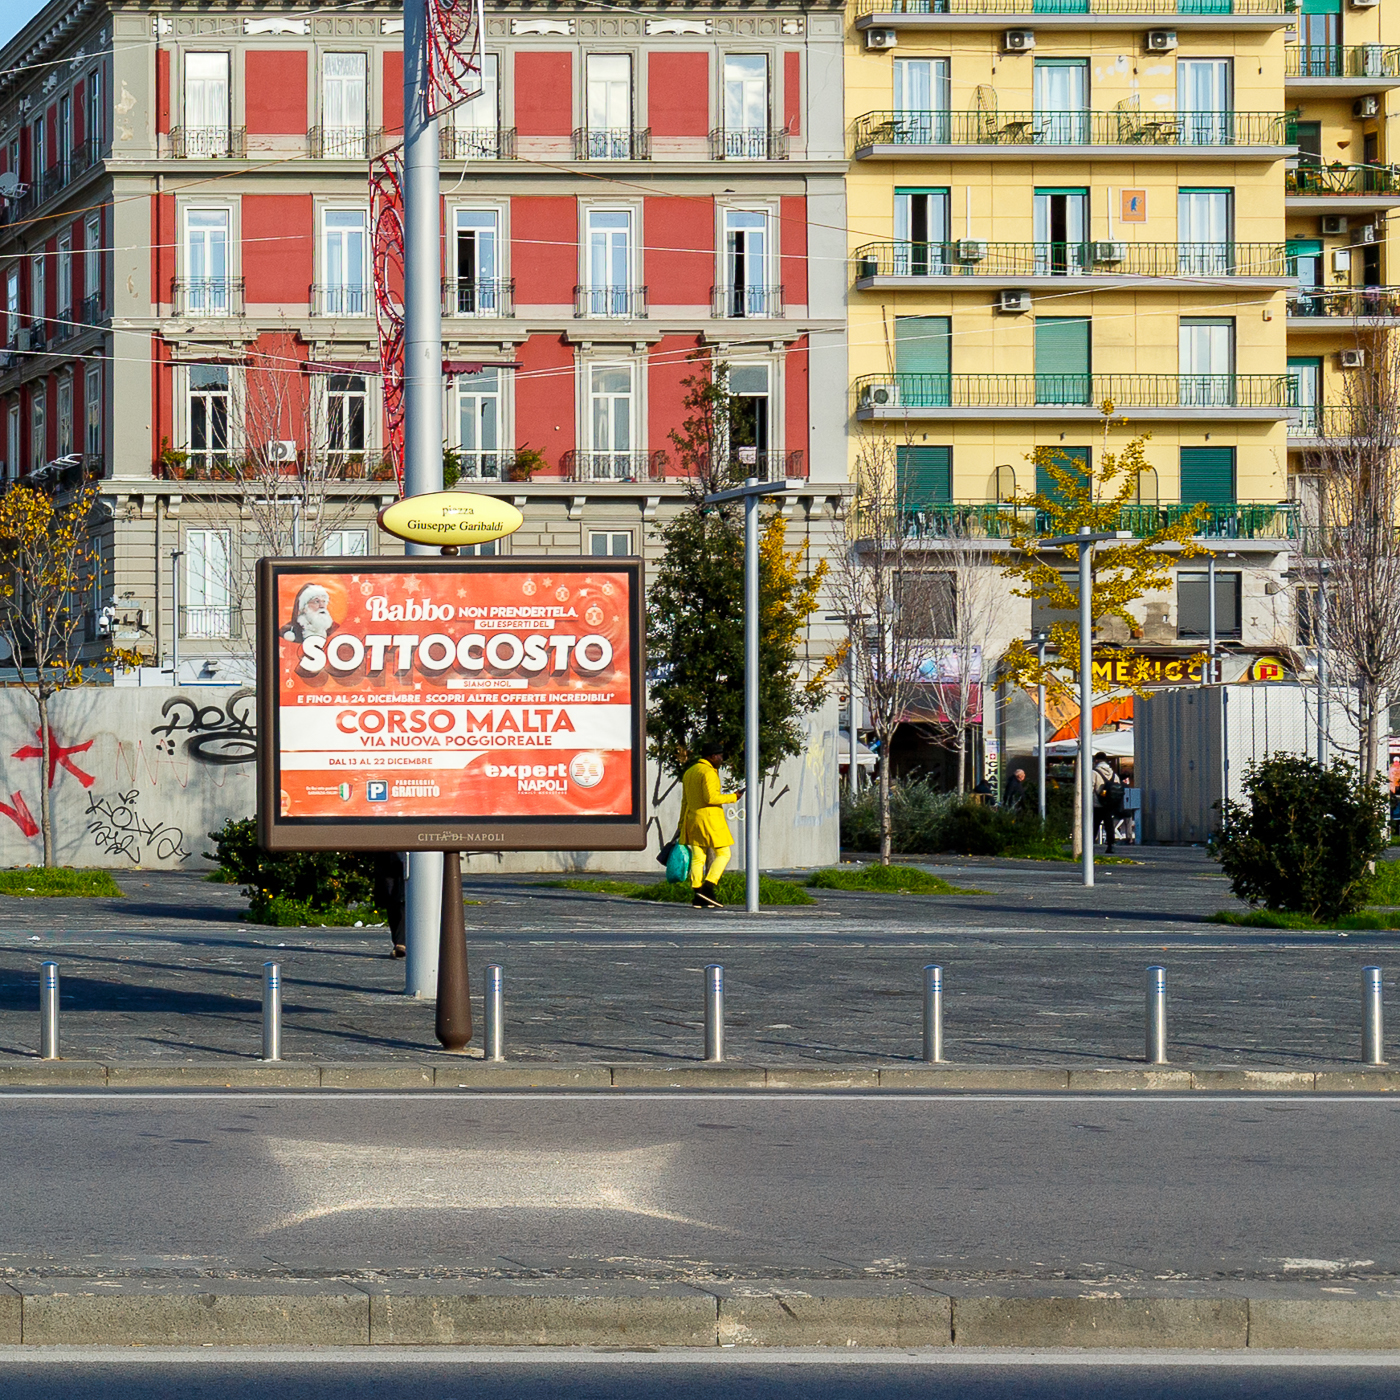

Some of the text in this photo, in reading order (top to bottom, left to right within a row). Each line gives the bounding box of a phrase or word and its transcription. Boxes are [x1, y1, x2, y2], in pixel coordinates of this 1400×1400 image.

[407, 520, 504, 532] Giuseppe Garibaldi
[365, 595, 579, 622] Babbo NON PRENDERTELA.
[300, 633, 614, 672] SOTTOCOSTO
[463, 680, 492, 688] SIAMO
[297, 695, 304, 704] E
[306, 695, 332, 704] FINO
[334, 694, 349, 703] AL
[350, 694, 365, 703] 24
[368, 694, 421, 703] DICEMBRE
[425, 694, 466, 703] SCOPRI
[467, 693, 498, 702] ALTRE
[501, 693, 547, 702] OFFERTE
[336, 708, 576, 734] CORSO MALTA
[360, 735, 552, 746] VIA NUOVA POGGIOREALE
[485, 763, 567, 780] expert
[517, 779, 568, 791] NAPOLI
[988, 761, 998, 800] CHAN
[370, 783, 441, 799] P GRATUITO
[452, 833, 463, 841] DI
[467, 833, 505, 841] NAPOLI
